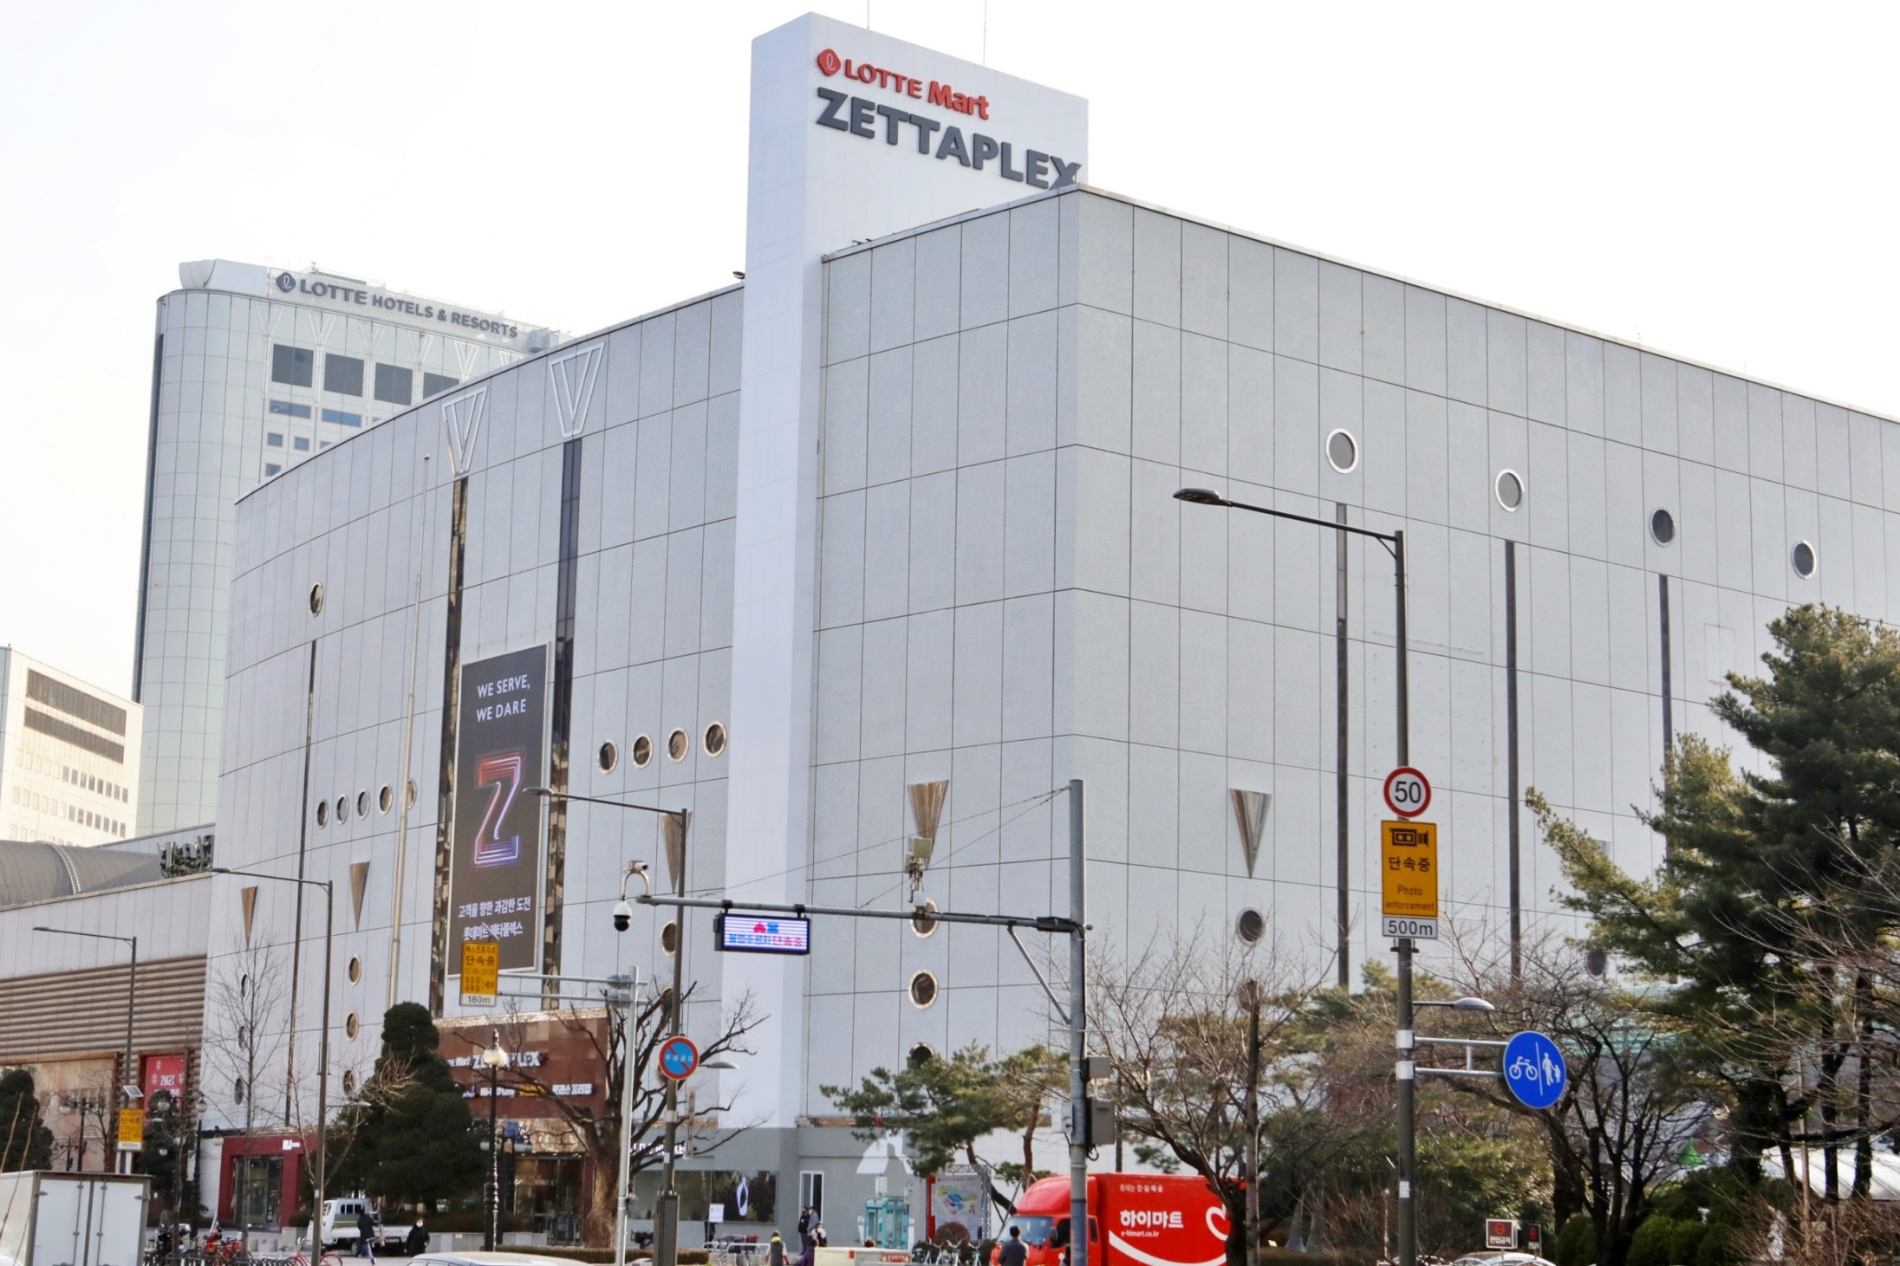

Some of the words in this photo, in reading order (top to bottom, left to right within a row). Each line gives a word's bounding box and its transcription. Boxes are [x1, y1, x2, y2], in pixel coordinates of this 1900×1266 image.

[845, 59, 922, 99] LOTTE
[928, 80, 989, 120] Mart
[817, 87, 1082, 190] ZETTAPLEX
[300, 278, 367, 305] LOTTE
[373, 294, 433, 319] HOTELS
[437, 309, 447, 322] &
[451, 311, 518, 338] RESORTS
[477, 682, 493, 698] WE
[496, 674, 530, 694] SERVE,
[476, 707, 493, 722] WE
[495, 699, 526, 718] DARE
[1394, 781, 1421, 803] 50
[1389, 857, 1431, 872] 단속중
[1397, 885, 1422, 896] Photo
[458, 903, 478, 918] 고객을
[480, 901, 493, 917] 향한
[494, 897, 515, 914] 과감한
[516, 895, 531, 911] 도전
[1386, 901, 1434, 911] enforcement
[1388, 920, 1433, 935] 500m
[466, 955, 495, 966] 단속중
[468, 996, 491, 1004] 180m
[1120, 1210, 1184, 1229] 하이마트
